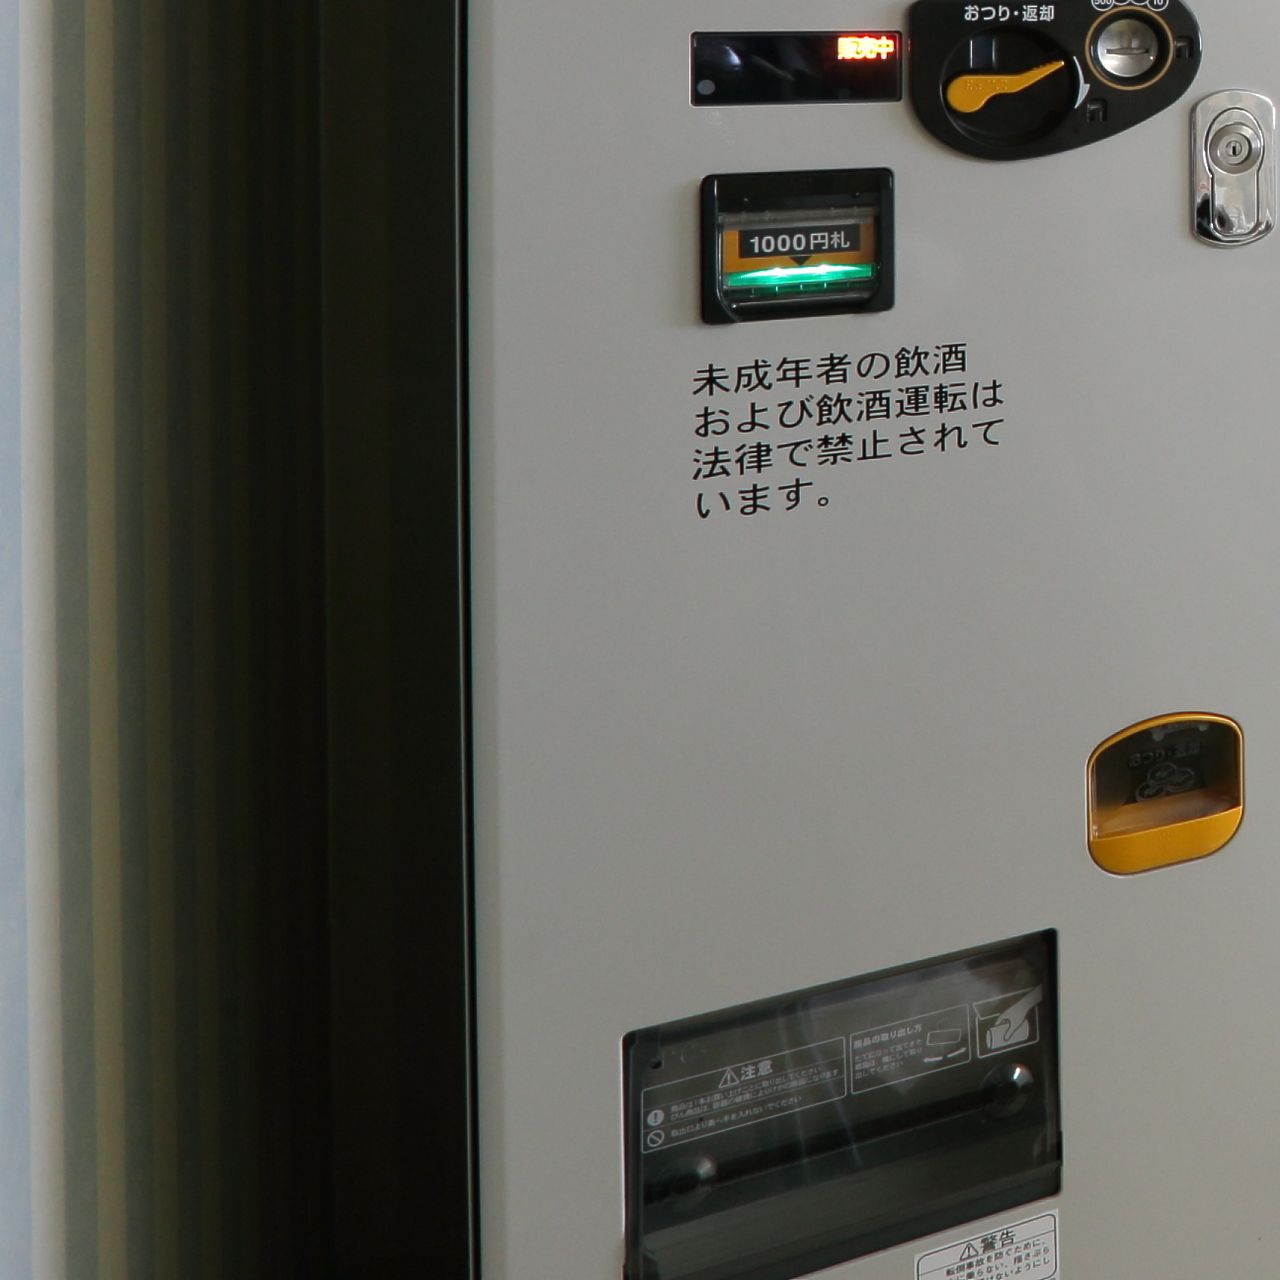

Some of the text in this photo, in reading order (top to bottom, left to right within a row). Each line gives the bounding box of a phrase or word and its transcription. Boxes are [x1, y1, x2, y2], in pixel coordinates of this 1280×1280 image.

[964, 4, 1055, 23] おつり・返却
[749, 231, 851, 254] 1000円札
[693, 343, 968, 397] 未成年者の飲酒
[693, 379, 1005, 438] および飲酒運転は
[692, 418, 1005, 481] 法律で禁止されて
[696, 477, 830, 519] います。
[740, 1058, 774, 1081] 注意
[980, 1228, 1017, 1254] 警告
